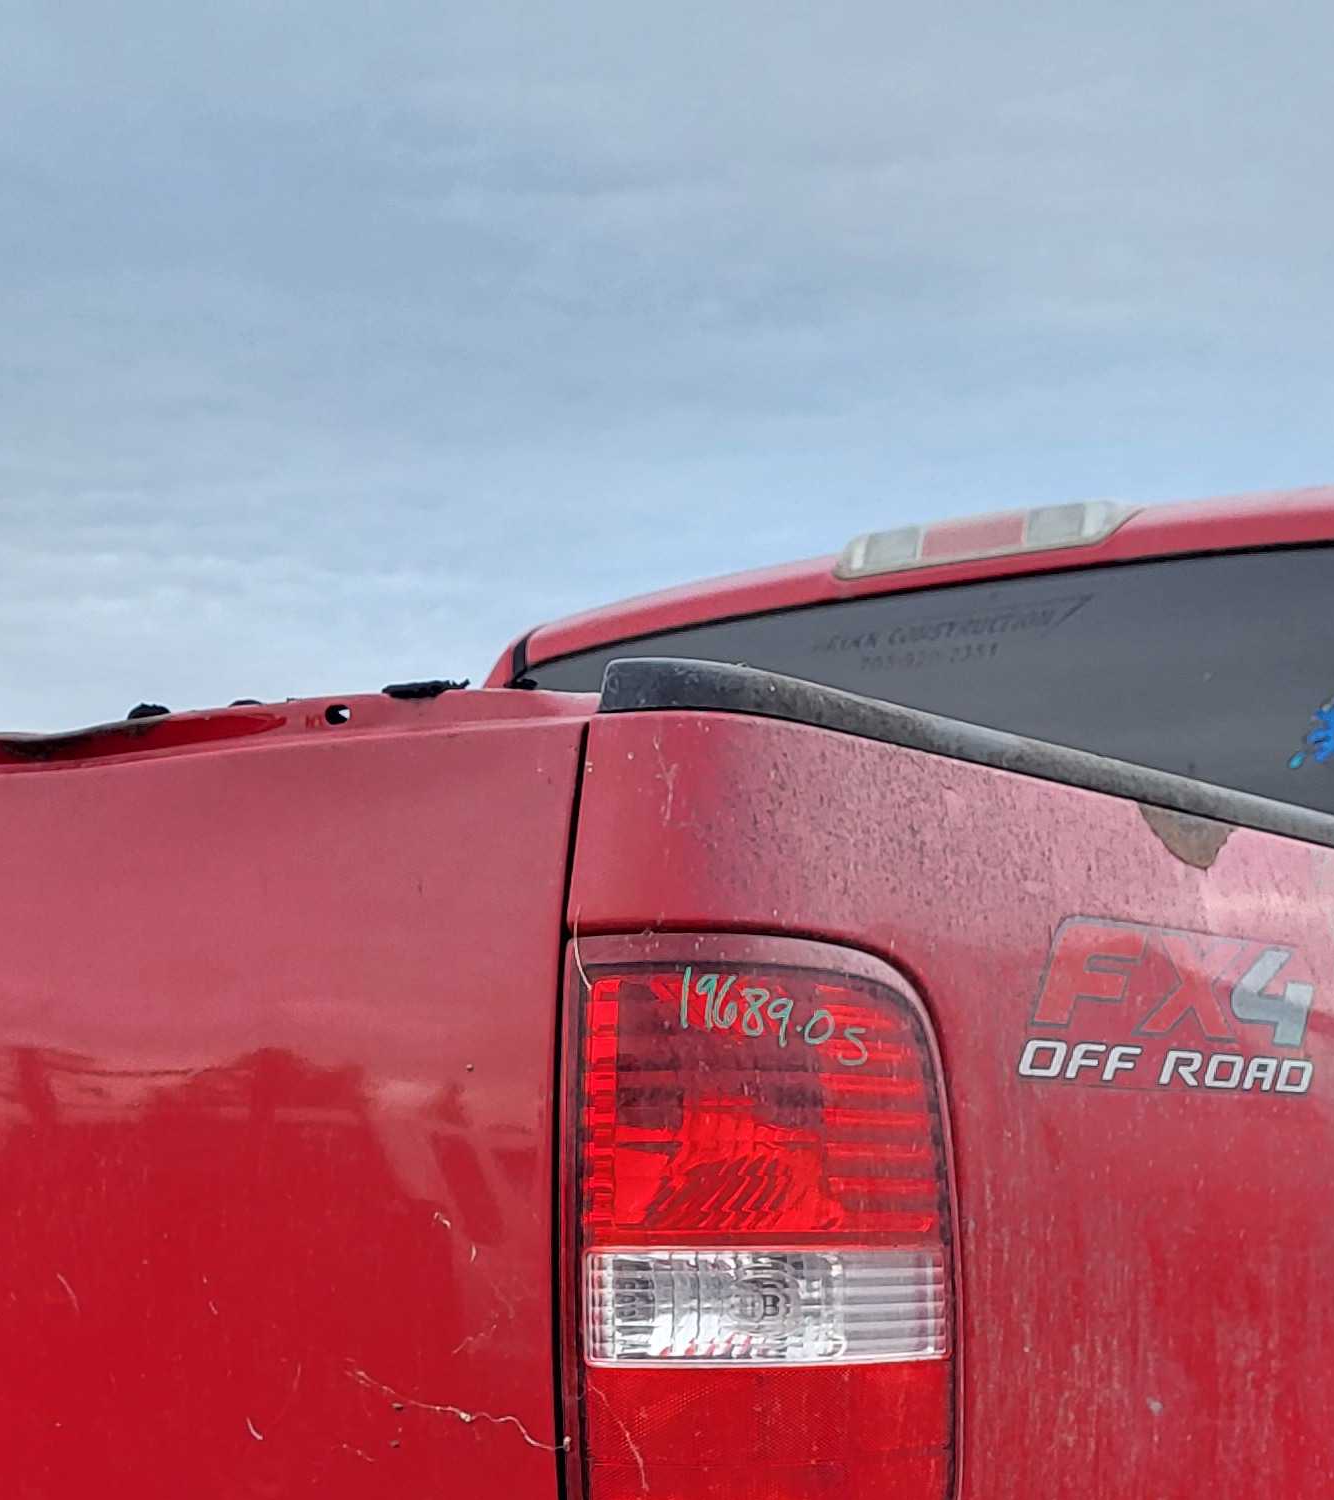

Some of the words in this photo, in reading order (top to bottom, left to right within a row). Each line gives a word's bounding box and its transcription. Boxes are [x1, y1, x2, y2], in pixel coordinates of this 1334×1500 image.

[1029, 920, 1315, 1048] FX4
[1018, 1038, 1143, 1082] OFF
[1158, 1049, 1315, 1094] ROAD
